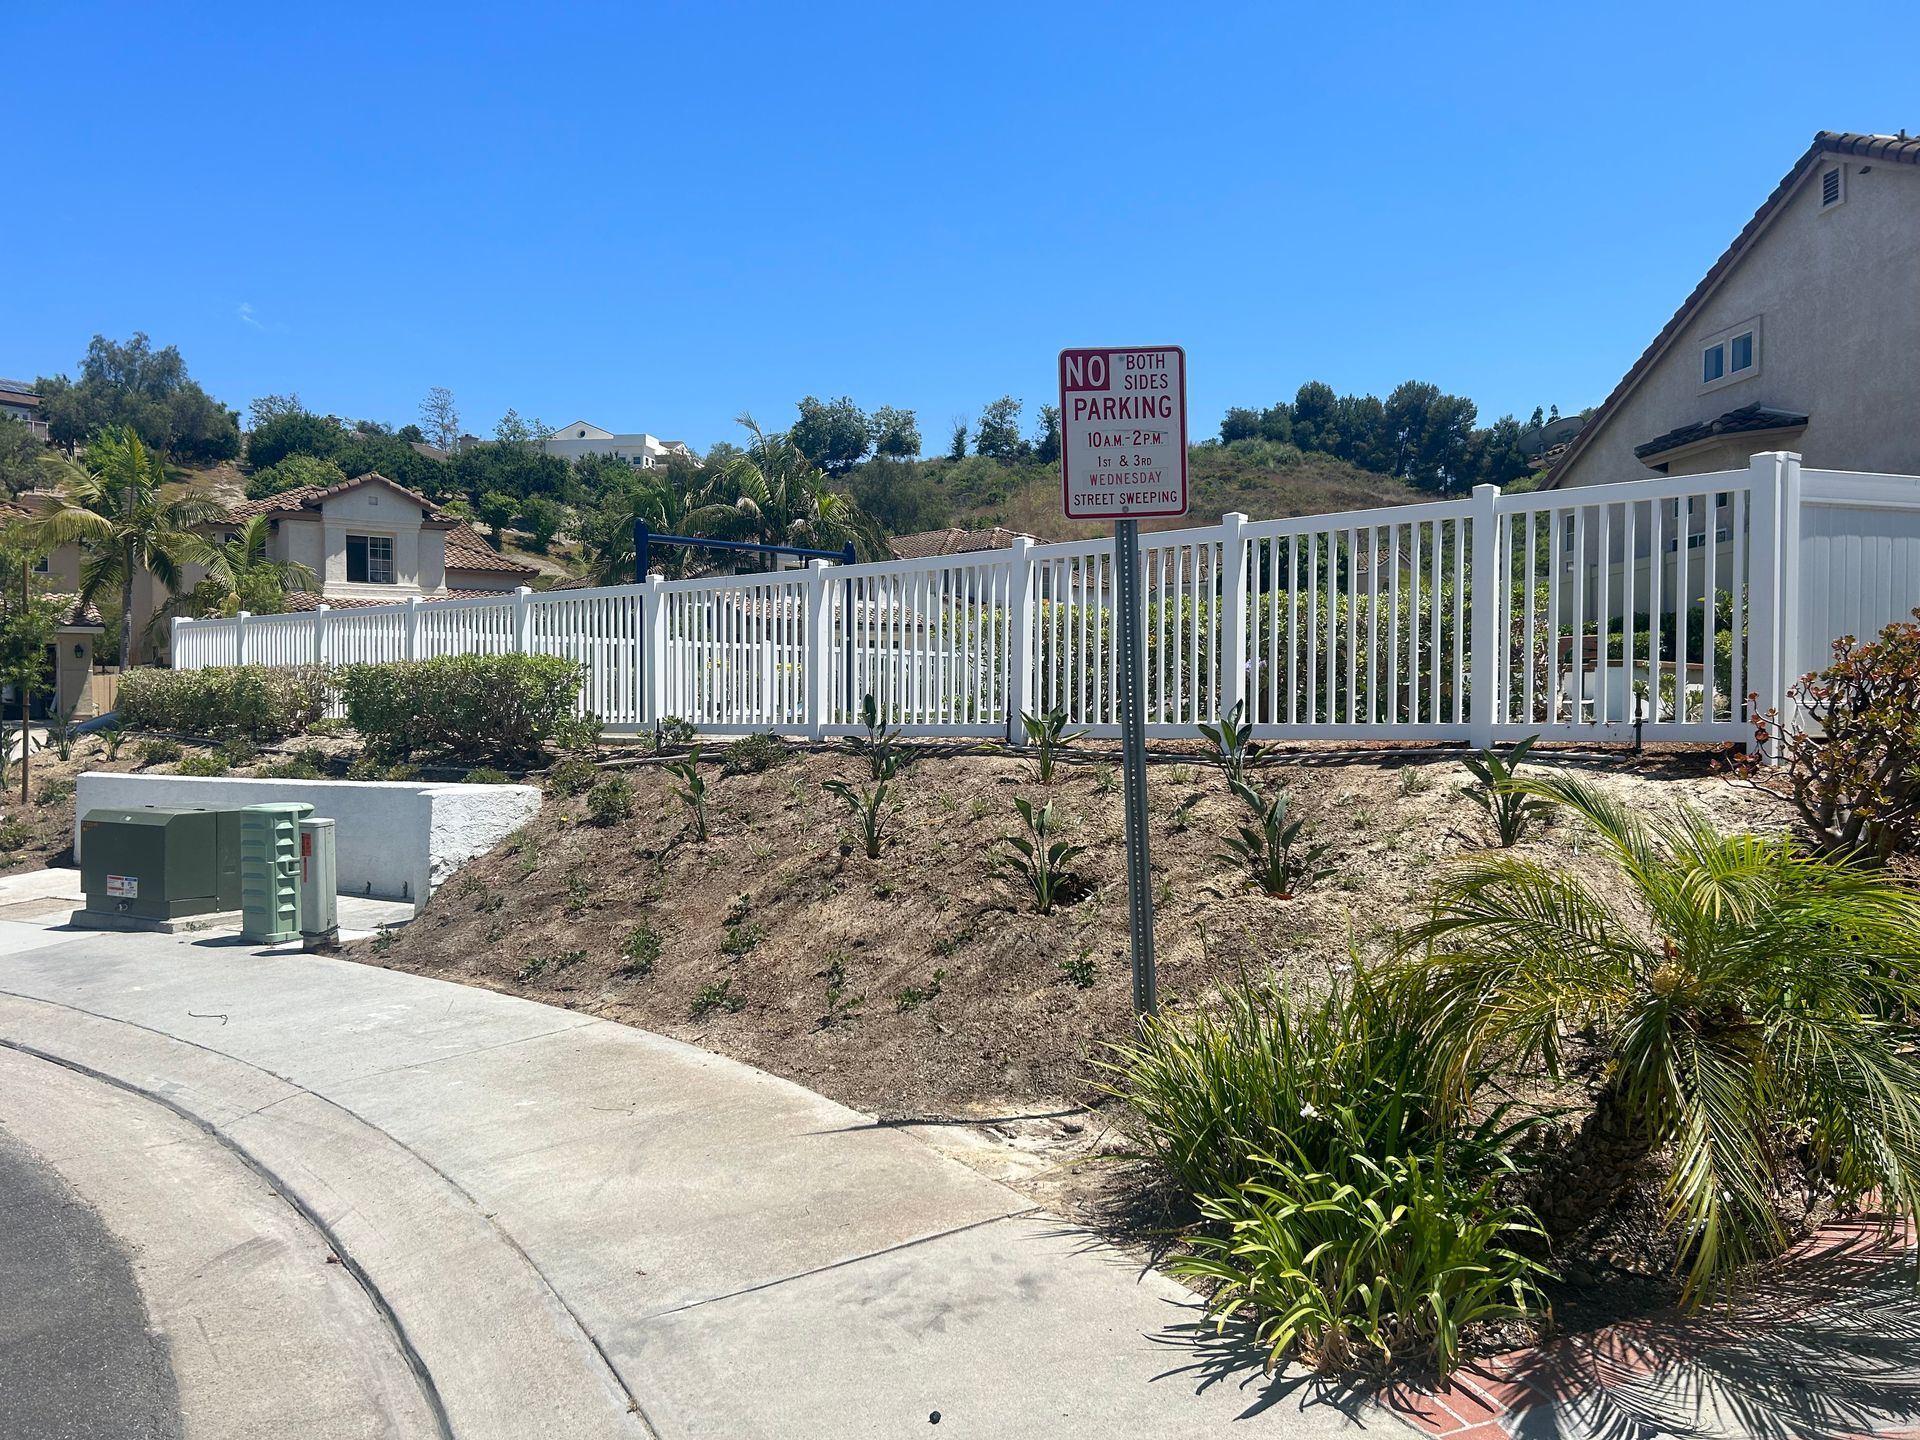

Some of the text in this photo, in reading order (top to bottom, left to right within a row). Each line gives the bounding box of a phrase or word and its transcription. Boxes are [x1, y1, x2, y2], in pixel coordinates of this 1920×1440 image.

[1126, 353, 1165, 370] BOTH
[1065, 355, 1106, 387] NO
[1124, 373, 1168, 390] SIDES
[1074, 395, 1172, 421] PARKING
[1098, 454, 1152, 467] 1ST & 3RD
[1089, 471, 1162, 486] WEDNESDAY
[1073, 490, 1178, 506] STREET SWEEPING
